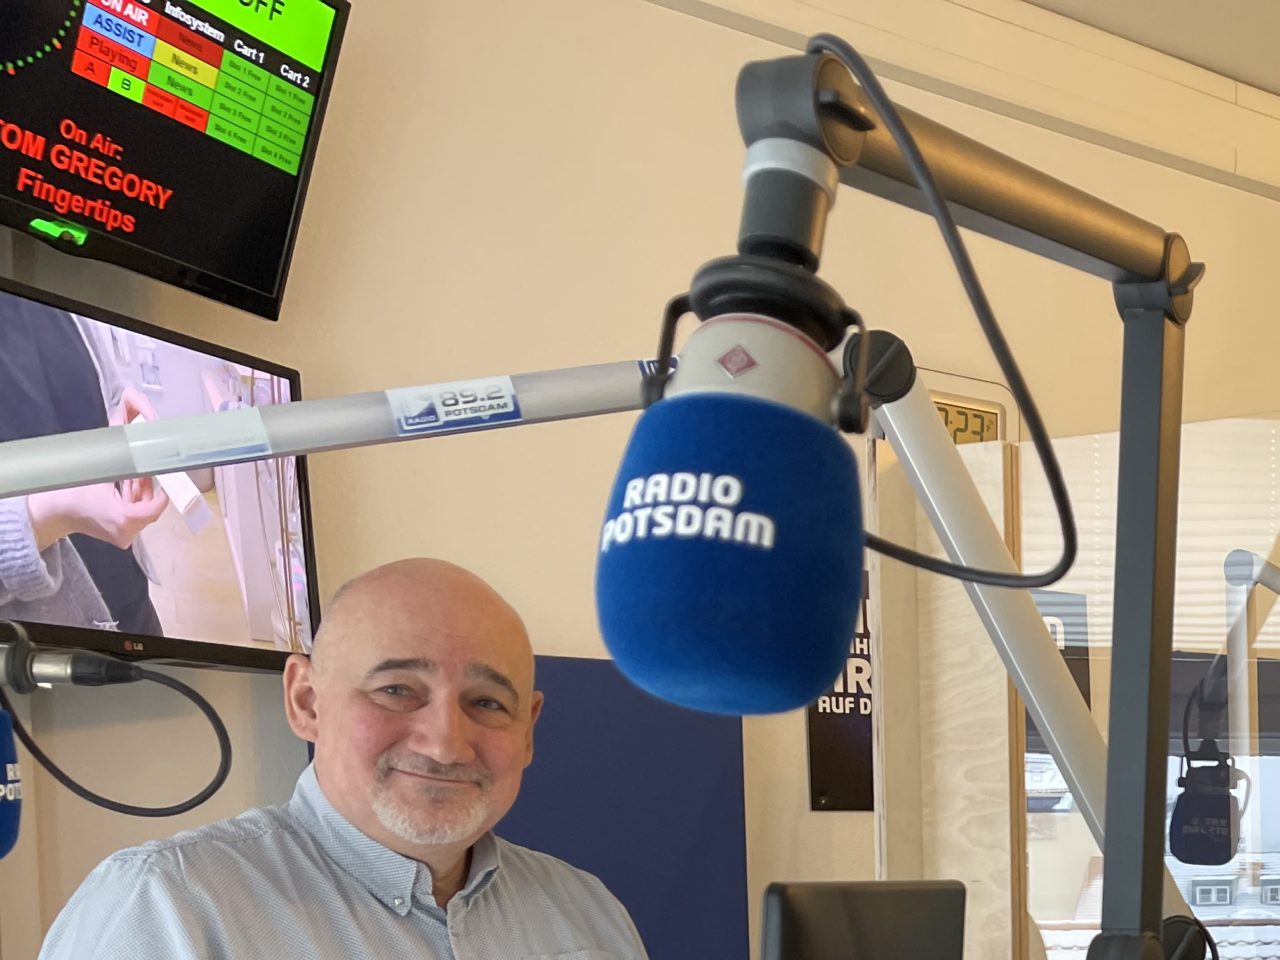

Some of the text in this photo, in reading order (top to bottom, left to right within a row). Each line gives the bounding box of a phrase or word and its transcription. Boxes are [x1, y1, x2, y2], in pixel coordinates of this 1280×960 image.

[123, 3, 149, 26] AIR
[164, 0, 224, 43] Infosystem
[93, 13, 145, 47] ASSIST
[89, 37, 138, 73] Playing
[233, 39, 265, 63] Cart 1
[84, 62, 96, 74] A
[171, 53, 199, 75] News
[121, 78, 131, 91] B
[166, 75, 193, 96] News
[280, 64, 310, 88] Cart 2
[60, 118, 124, 161] On Air:
[0, 119, 174, 210] OM GREGORY
[17, 167, 136, 233] Fingertips
[440, 385, 505, 407] 89.2
[407, 415, 436, 424] RADIO
[444, 402, 508, 417] POTSDAM
[623, 472, 742, 509] RADIO
[601, 504, 775, 552] POTSDAM
[133, 642, 144, 651] LG
[818, 695, 854, 714] AUF
